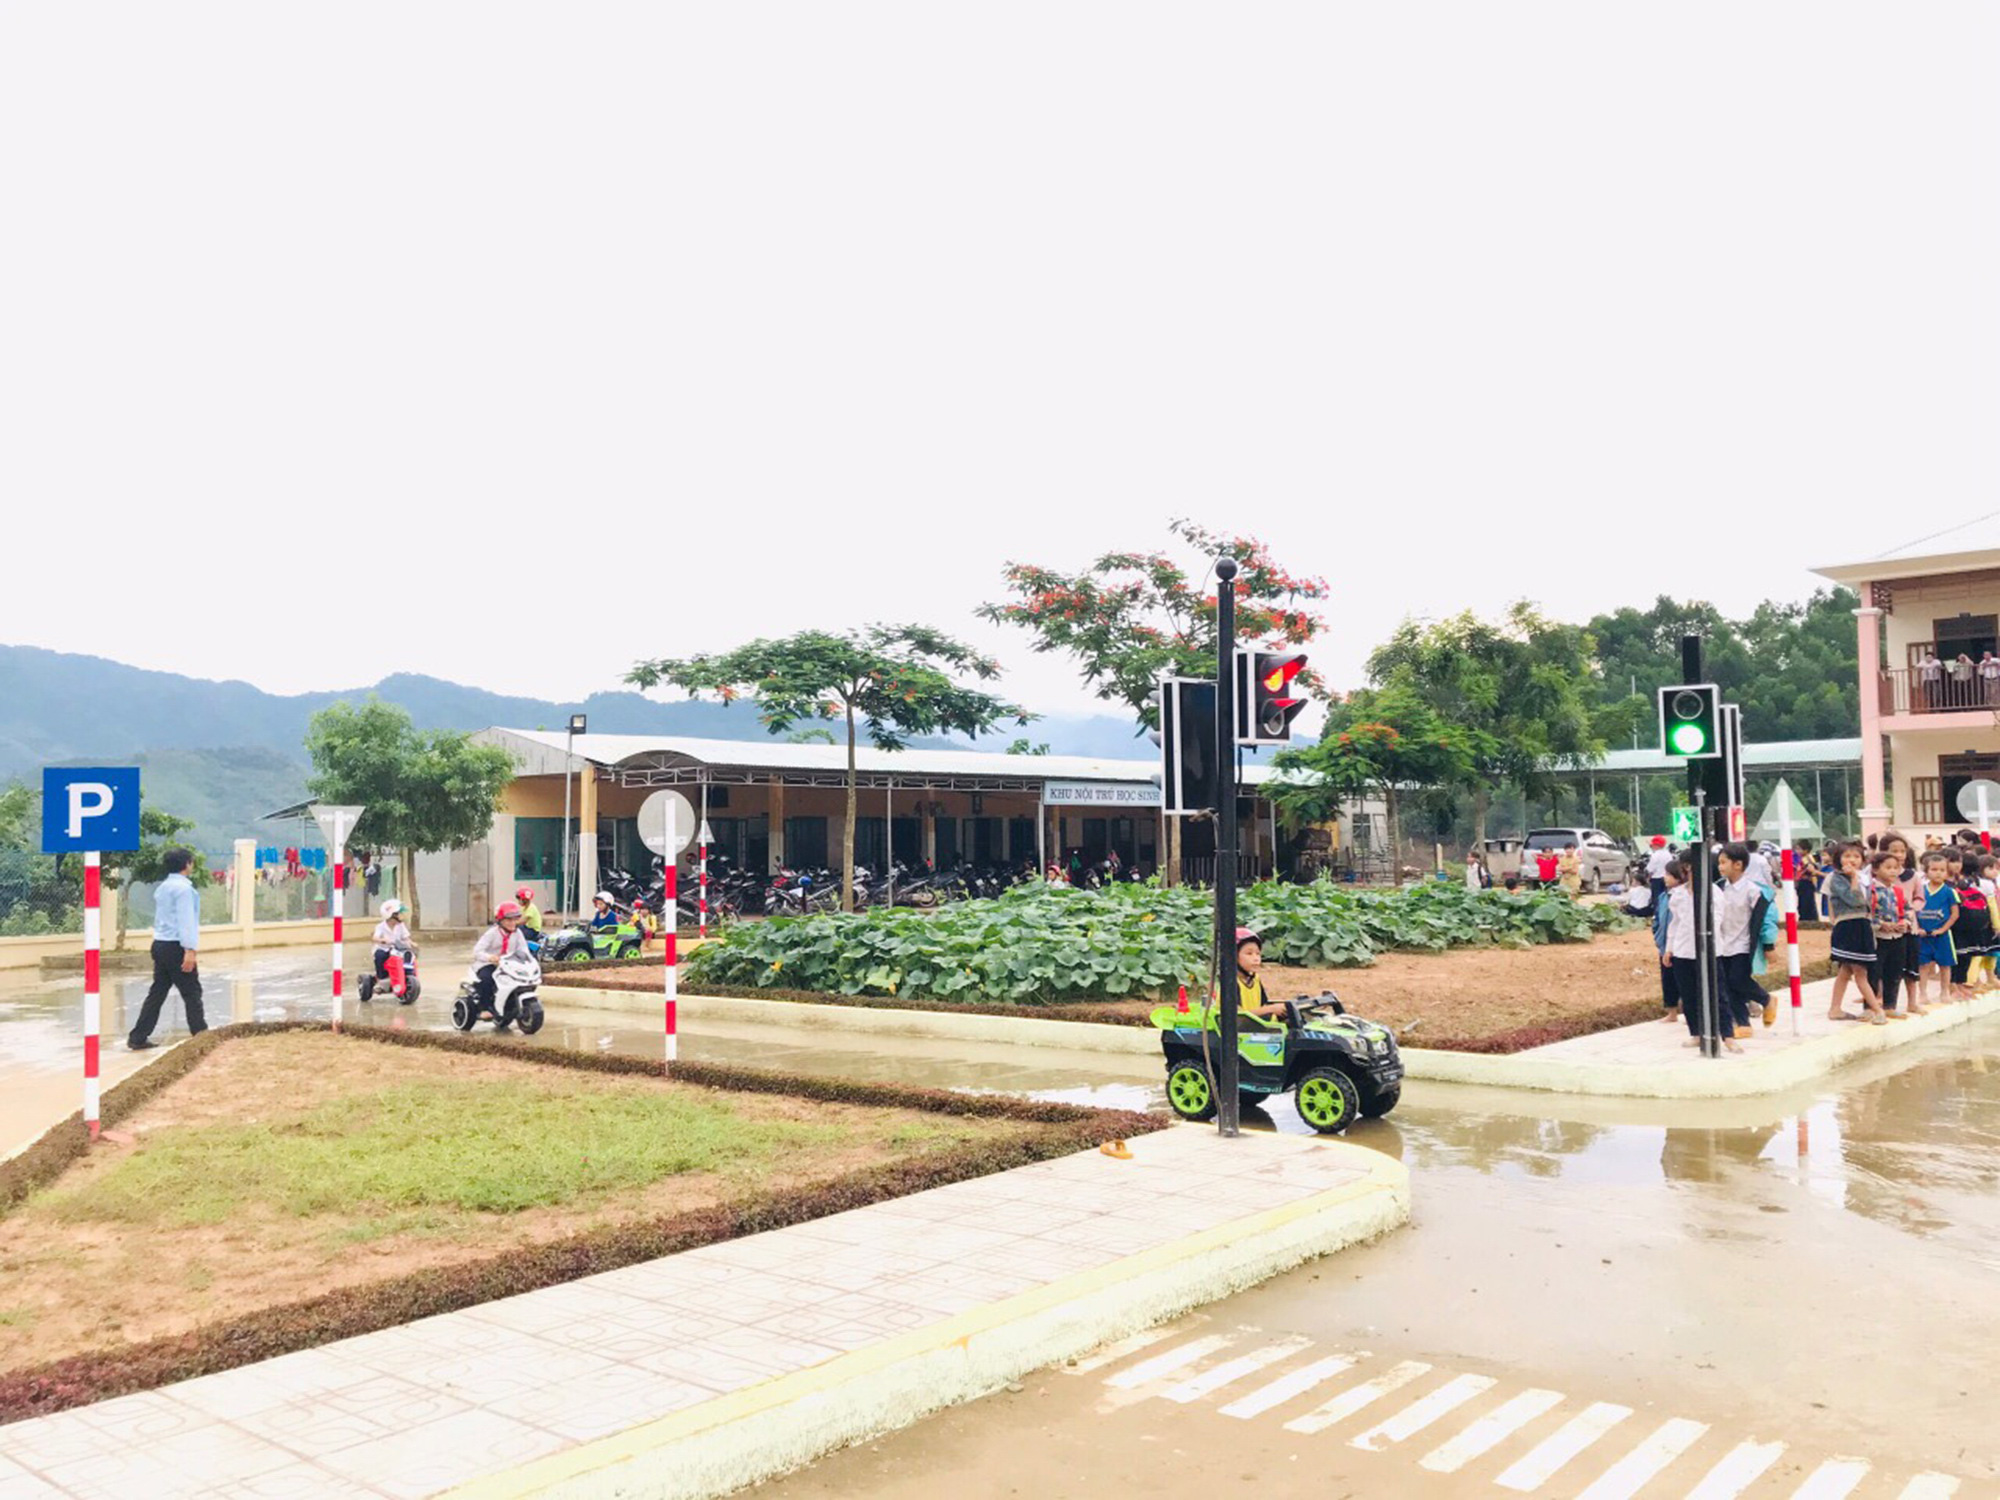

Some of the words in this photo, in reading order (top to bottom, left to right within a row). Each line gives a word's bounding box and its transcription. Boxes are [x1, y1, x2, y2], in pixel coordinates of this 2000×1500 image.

[69, 782, 114, 838] P
[1050, 788, 1072, 799] KHU
[1074, 787, 1093, 802] NỘI
[1095, 786, 1114, 800] TRÚ
[1117, 790, 1136, 802] HỌC
[1137, 790, 1160, 801] SINH
